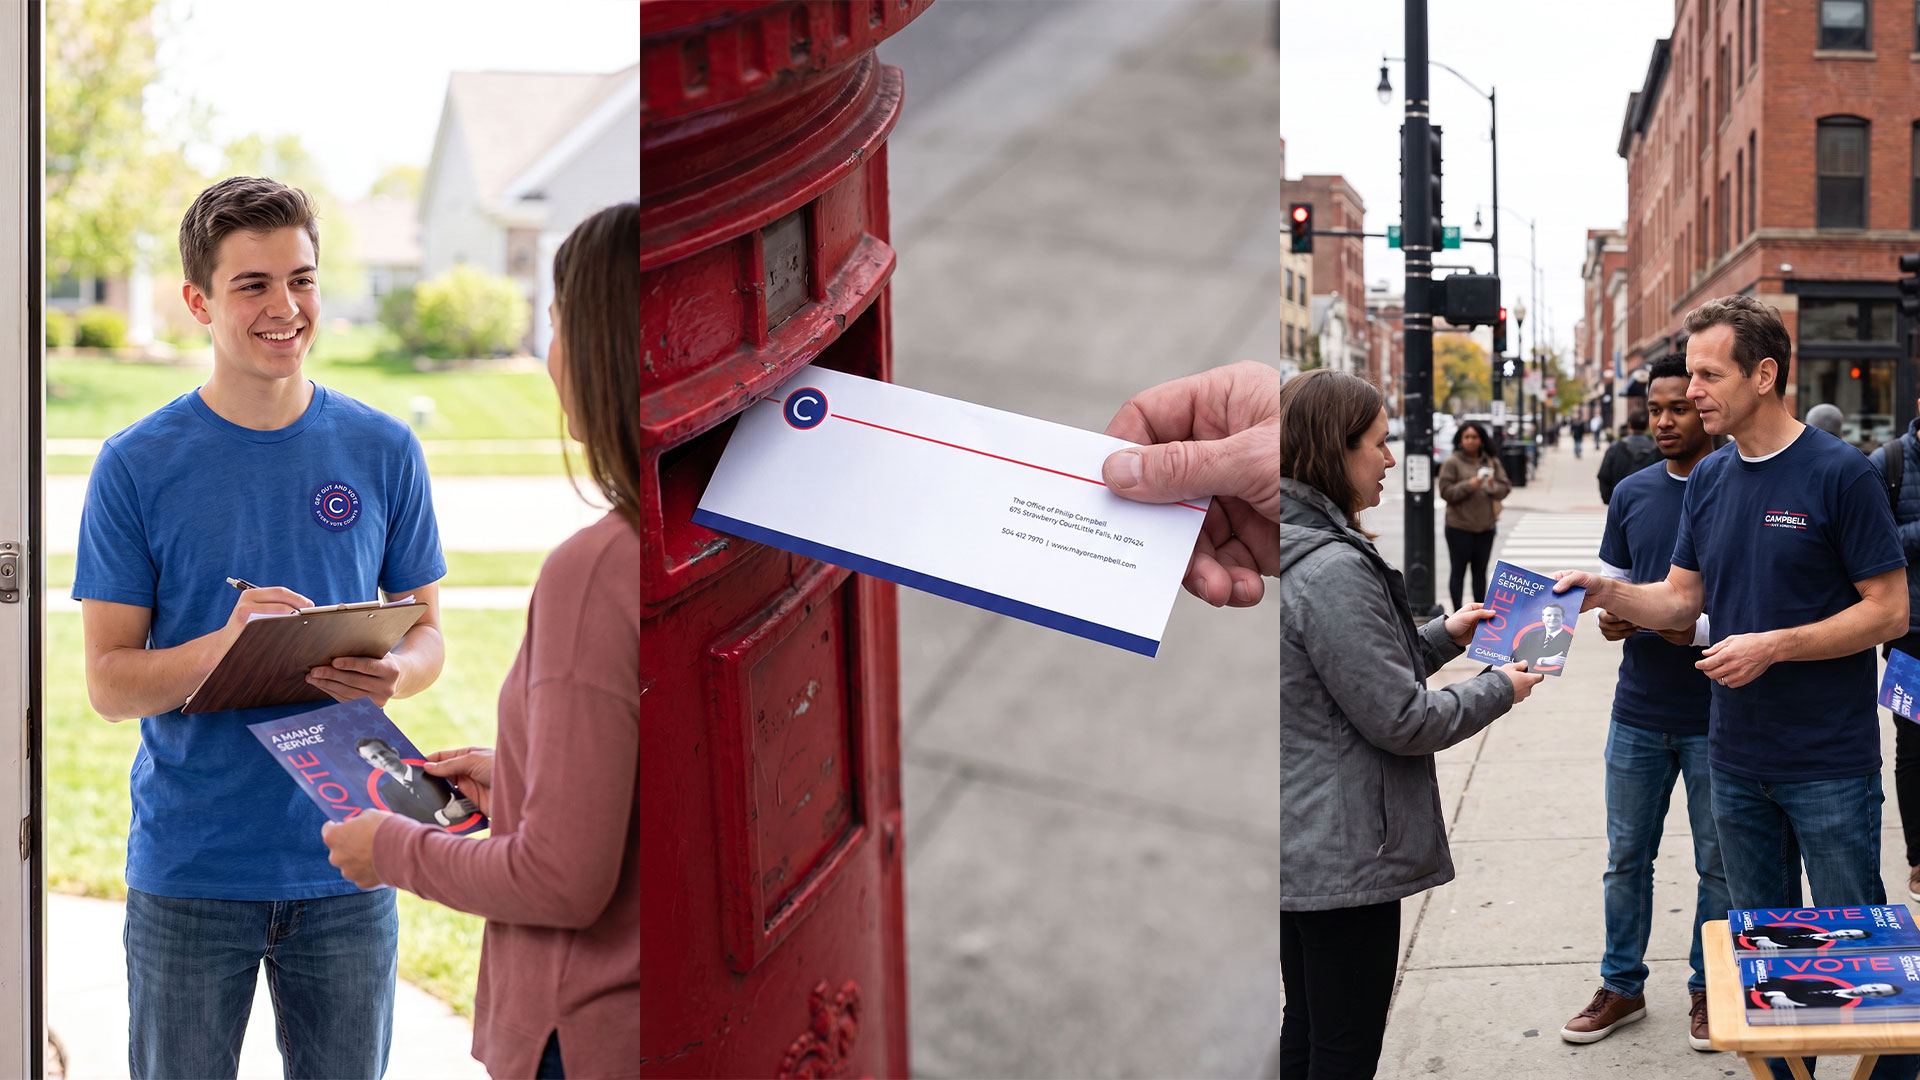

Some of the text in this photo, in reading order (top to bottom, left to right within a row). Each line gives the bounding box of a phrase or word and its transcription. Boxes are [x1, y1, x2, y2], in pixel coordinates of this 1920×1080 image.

[793, 396, 818, 421] C
[314, 484, 359, 506] GET OUT AND VOTE
[329, 497, 344, 513] C
[316, 510, 329, 524] EVERY
[1013, 496, 1026, 506] The
[1026, 500, 1046, 511] Office
[1054, 508, 1075, 519] Philip
[1074, 513, 1108, 528] Campbell
[1764, 514, 1807, 526] CAMPBELL
[1009, 505, 1022, 515] 675
[1022, 509, 1059, 525] Strawberry
[1094, 528, 1112, 540] Falls,
[1112, 533, 1123, 542] NJ
[1123, 536, 1145, 548] 07424
[1001, 527, 1015, 536] 504
[1015, 531, 1027, 540] 412
[1027, 534, 1044, 544] 7970
[1051, 542, 1138, 570] www.mayorcampbell.com
[1497, 578, 1536, 597] SERVICE
[1500, 571, 1507, 579] A
[1508, 574, 1530, 587] MAN
[1531, 582, 1545, 591] OF
[1480, 588, 1516, 641] VOTE
[271, 735, 281, 744] A
[280, 728, 309, 742] MAN
[308, 724, 325, 735] OF
[276, 734, 325, 752] SERVICE
[287, 751, 362, 822] VOTE
[1767, 908, 1866, 921] VOTE
[1784, 956, 1895, 973] VOTE
